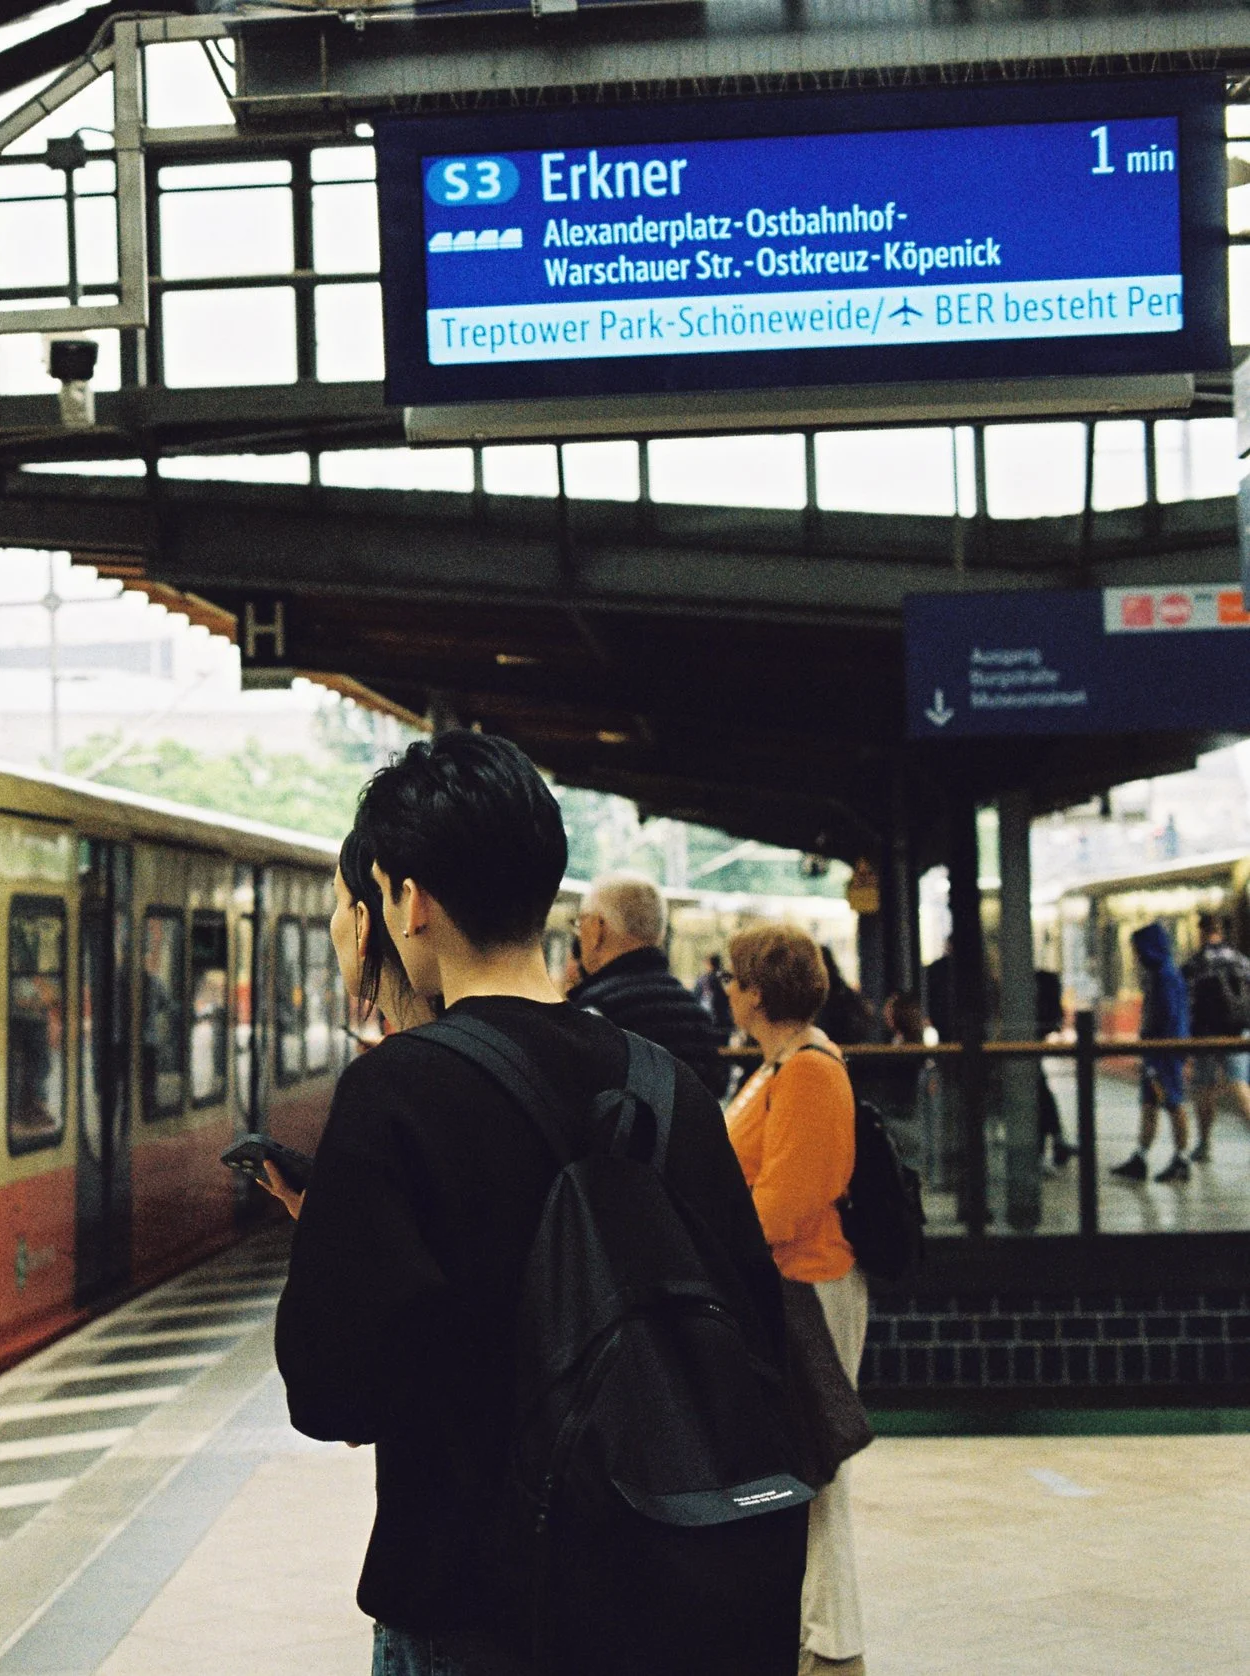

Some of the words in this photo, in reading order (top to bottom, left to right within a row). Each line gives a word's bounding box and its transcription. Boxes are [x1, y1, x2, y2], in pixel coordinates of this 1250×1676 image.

[540, 150, 688, 202] Erkner
[1090, 125, 1115, 175] 1
[1126, 144, 1176, 173] min
[543, 254, 691, 287] Warschauer
[441, 317, 590, 353] Treptower
[936, 294, 996, 326] BER
[1003, 287, 1118, 323] besteht
[244, 600, 285, 658] H
